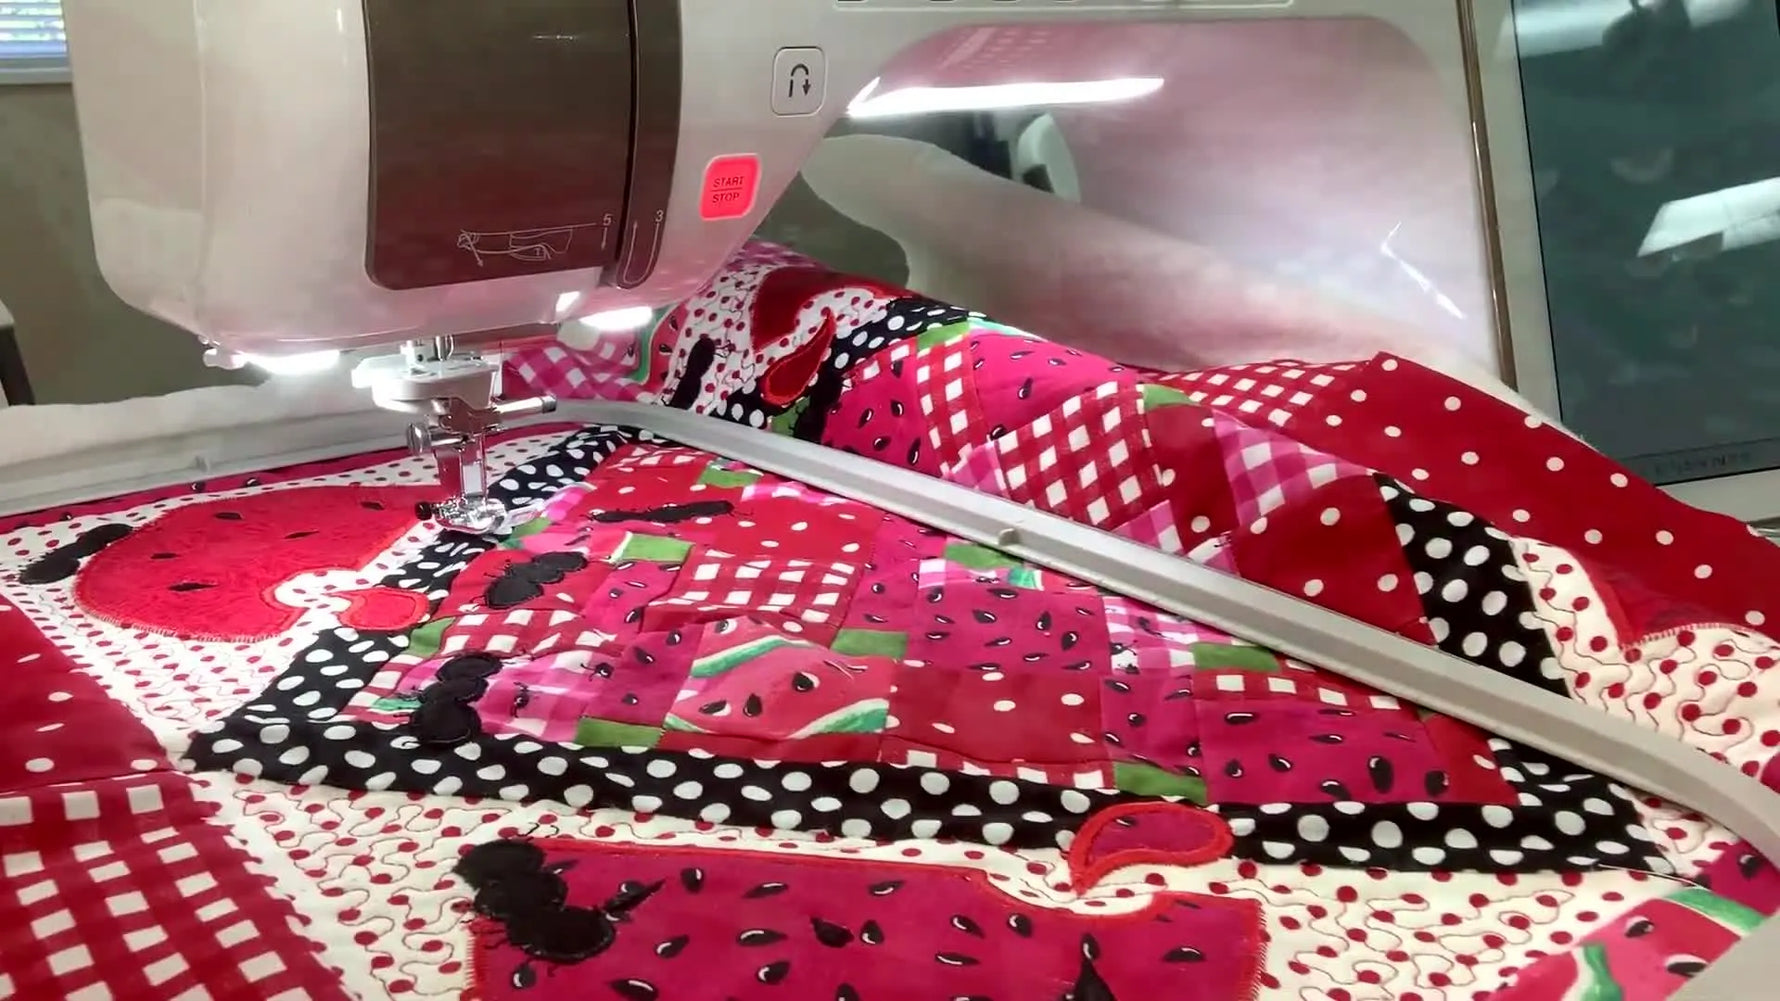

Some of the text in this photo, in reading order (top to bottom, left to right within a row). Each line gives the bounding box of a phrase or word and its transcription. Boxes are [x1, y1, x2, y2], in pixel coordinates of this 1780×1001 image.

[713, 176, 744, 188] START
[712, 192, 740, 203] STOP
[602, 213, 611, 226] 5
[655, 210, 664, 223] 3
